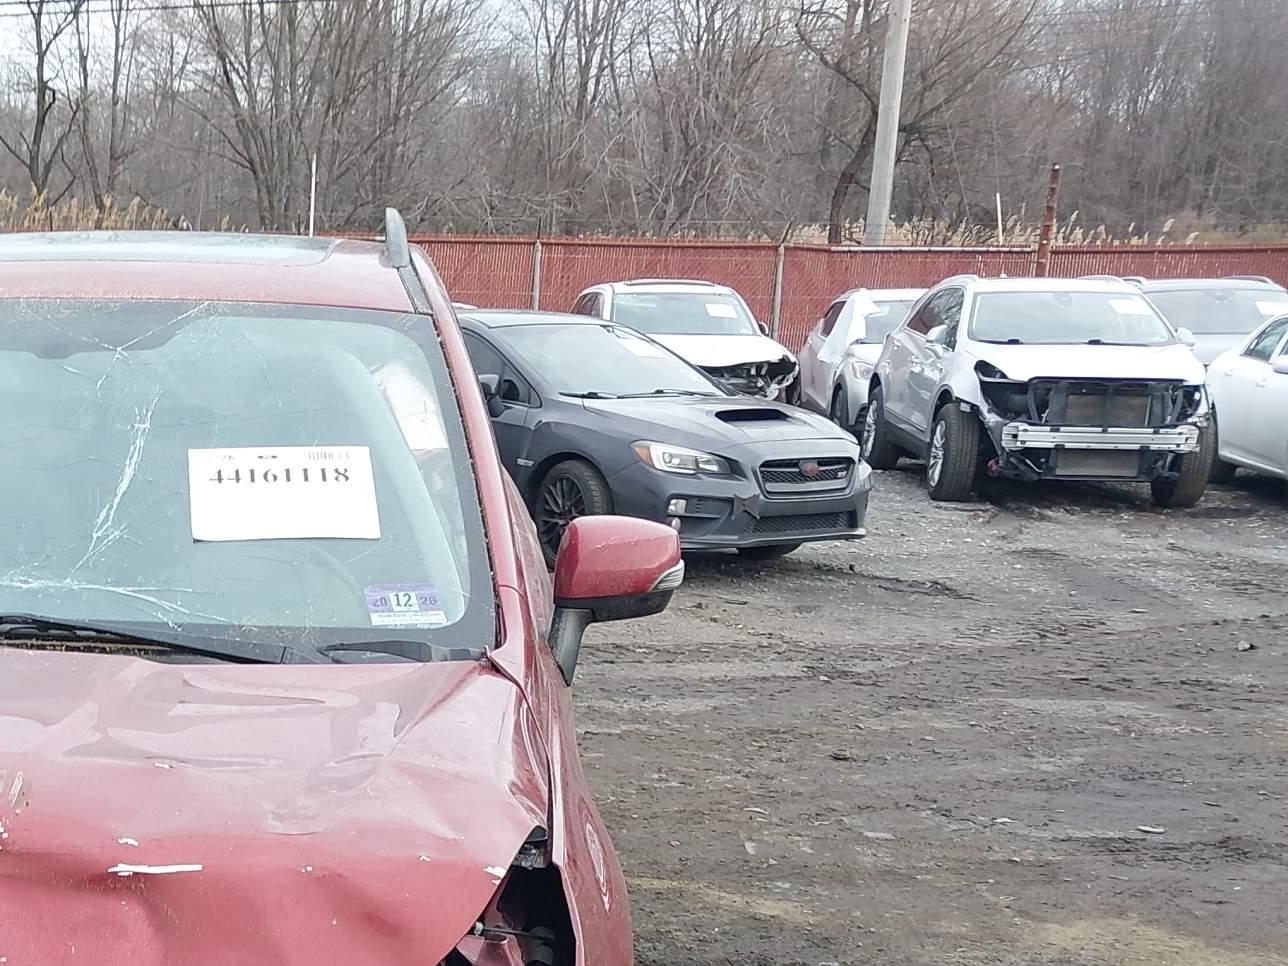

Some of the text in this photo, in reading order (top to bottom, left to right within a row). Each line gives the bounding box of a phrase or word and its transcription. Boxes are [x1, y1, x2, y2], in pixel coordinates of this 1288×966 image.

[209, 467, 351, 484] 44161118
[372, 596, 388, 607] 20
[393, 593, 413, 608] 12
